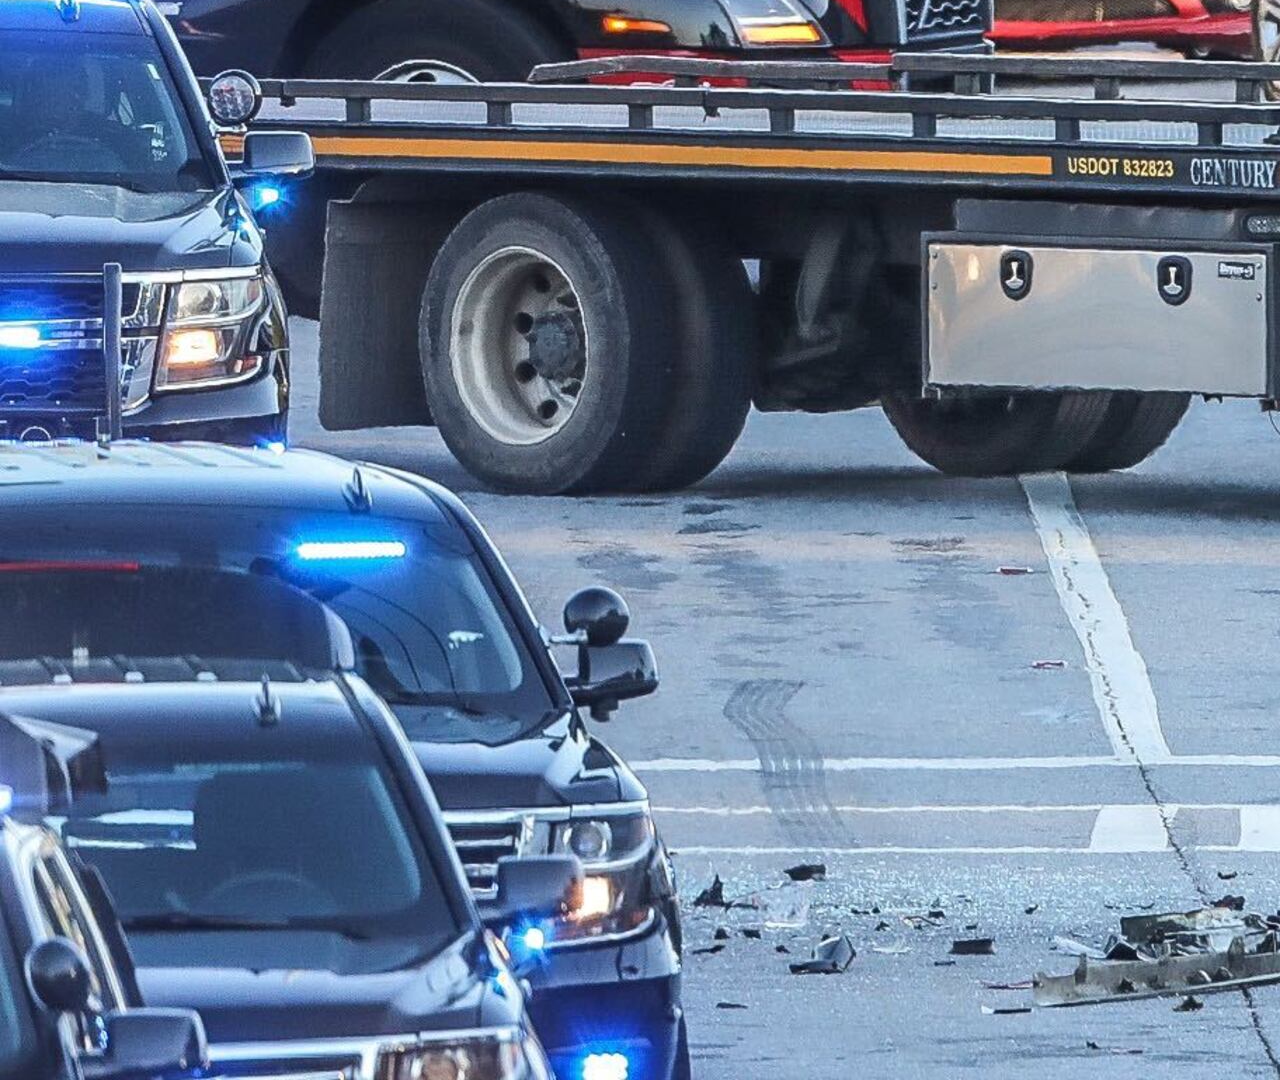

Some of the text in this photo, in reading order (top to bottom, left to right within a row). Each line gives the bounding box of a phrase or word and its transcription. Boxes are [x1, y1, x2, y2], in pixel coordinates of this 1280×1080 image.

[1067, 156, 1175, 178] USDOT 832823
[1190, 158, 1277, 188] CENTURY
